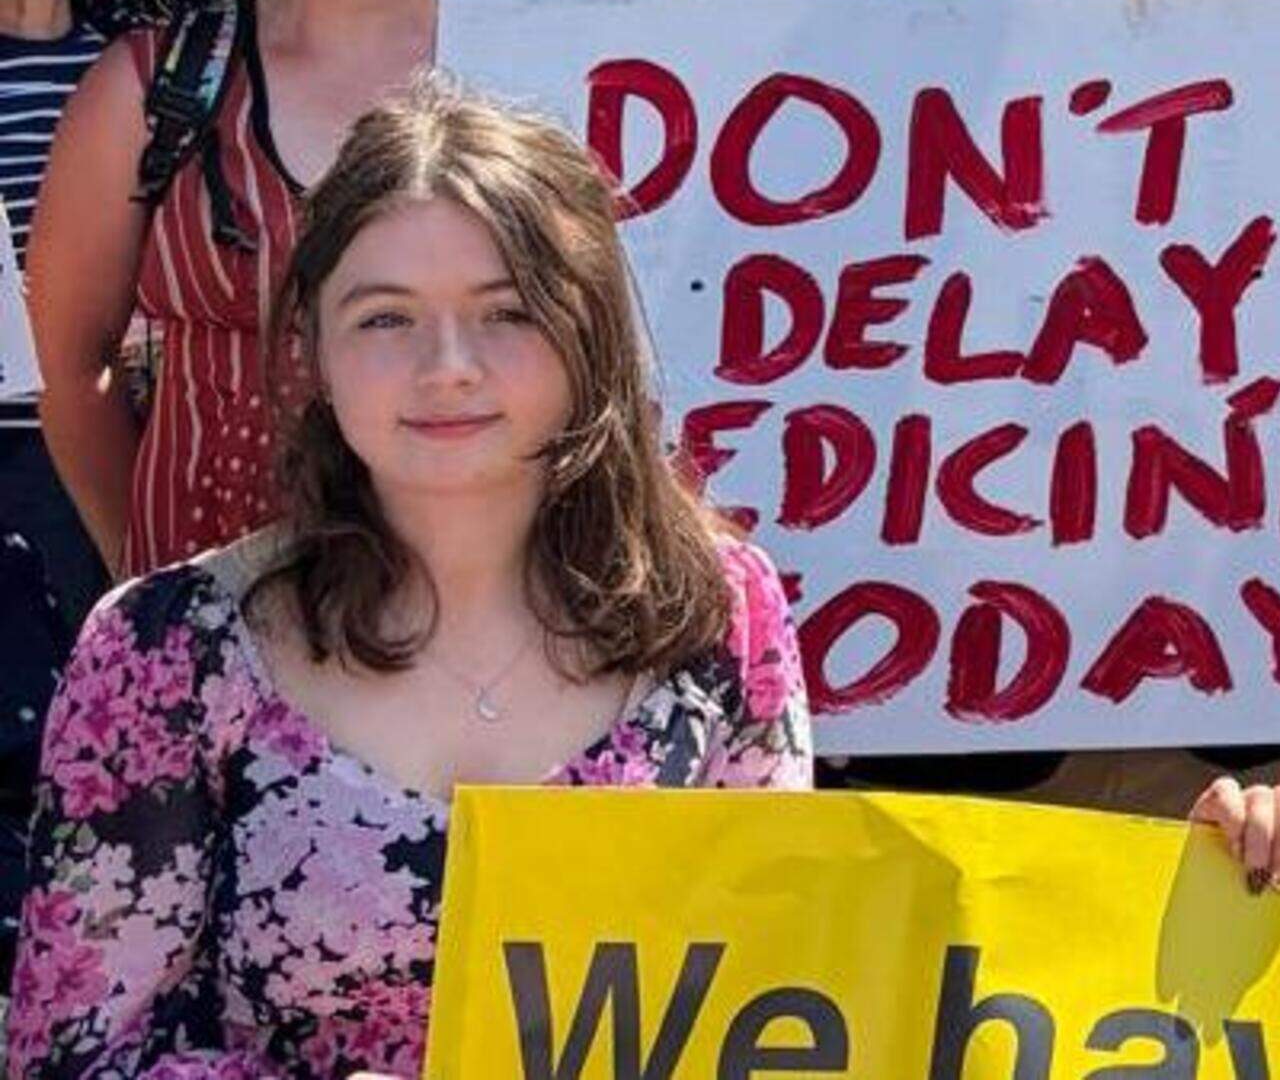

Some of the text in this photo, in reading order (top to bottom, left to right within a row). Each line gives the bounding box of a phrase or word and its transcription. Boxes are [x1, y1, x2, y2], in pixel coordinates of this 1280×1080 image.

[585, 58, 1233, 241] DON'T
[714, 215, 1279, 386] DELAY
[502, 941, 850, 1080] We
